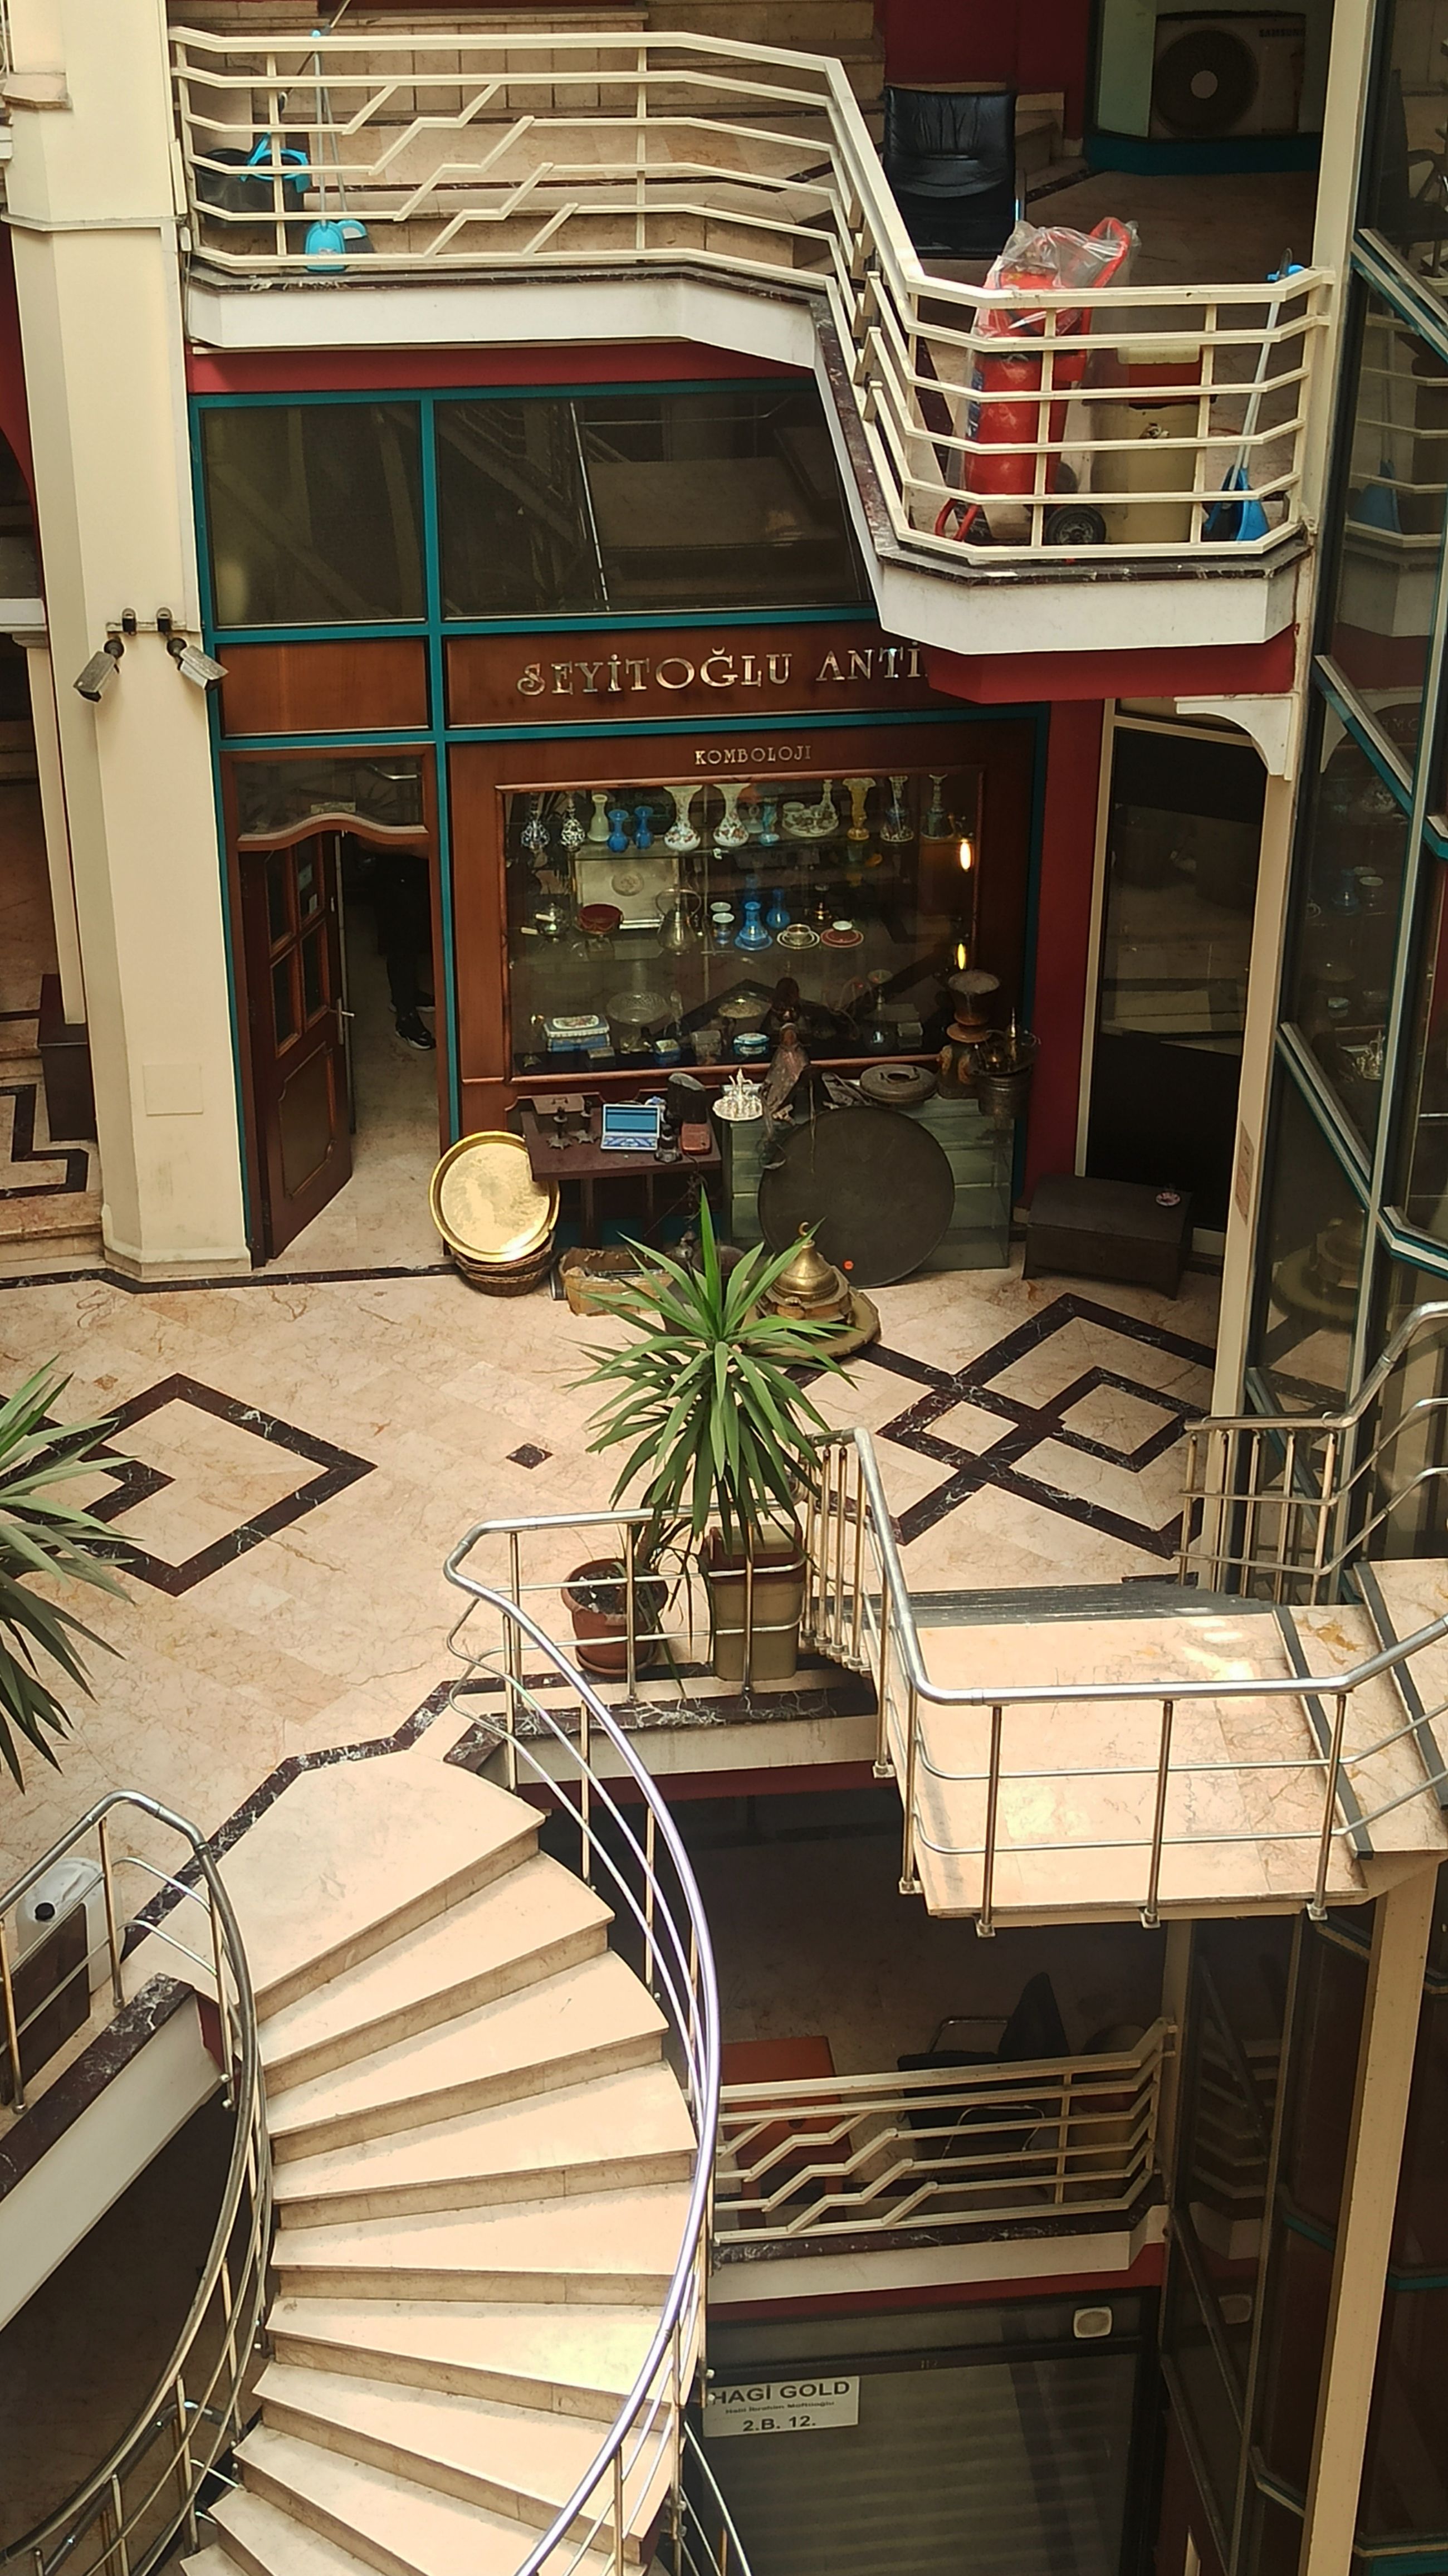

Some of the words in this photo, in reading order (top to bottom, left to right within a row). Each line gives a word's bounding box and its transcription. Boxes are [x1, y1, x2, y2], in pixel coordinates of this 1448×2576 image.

[517, 647, 792, 695] SEYİTOĞLU
[816, 642, 928, 681] ANTİ
[694, 746, 811, 765] KOMBOLOJI
[712, 2385, 771, 2405] HAGİ
[780, 2382, 850, 2398] GOLD
[742, 2418, 780, 2432] 2.B.
[789, 2416, 816, 2427] 12.
